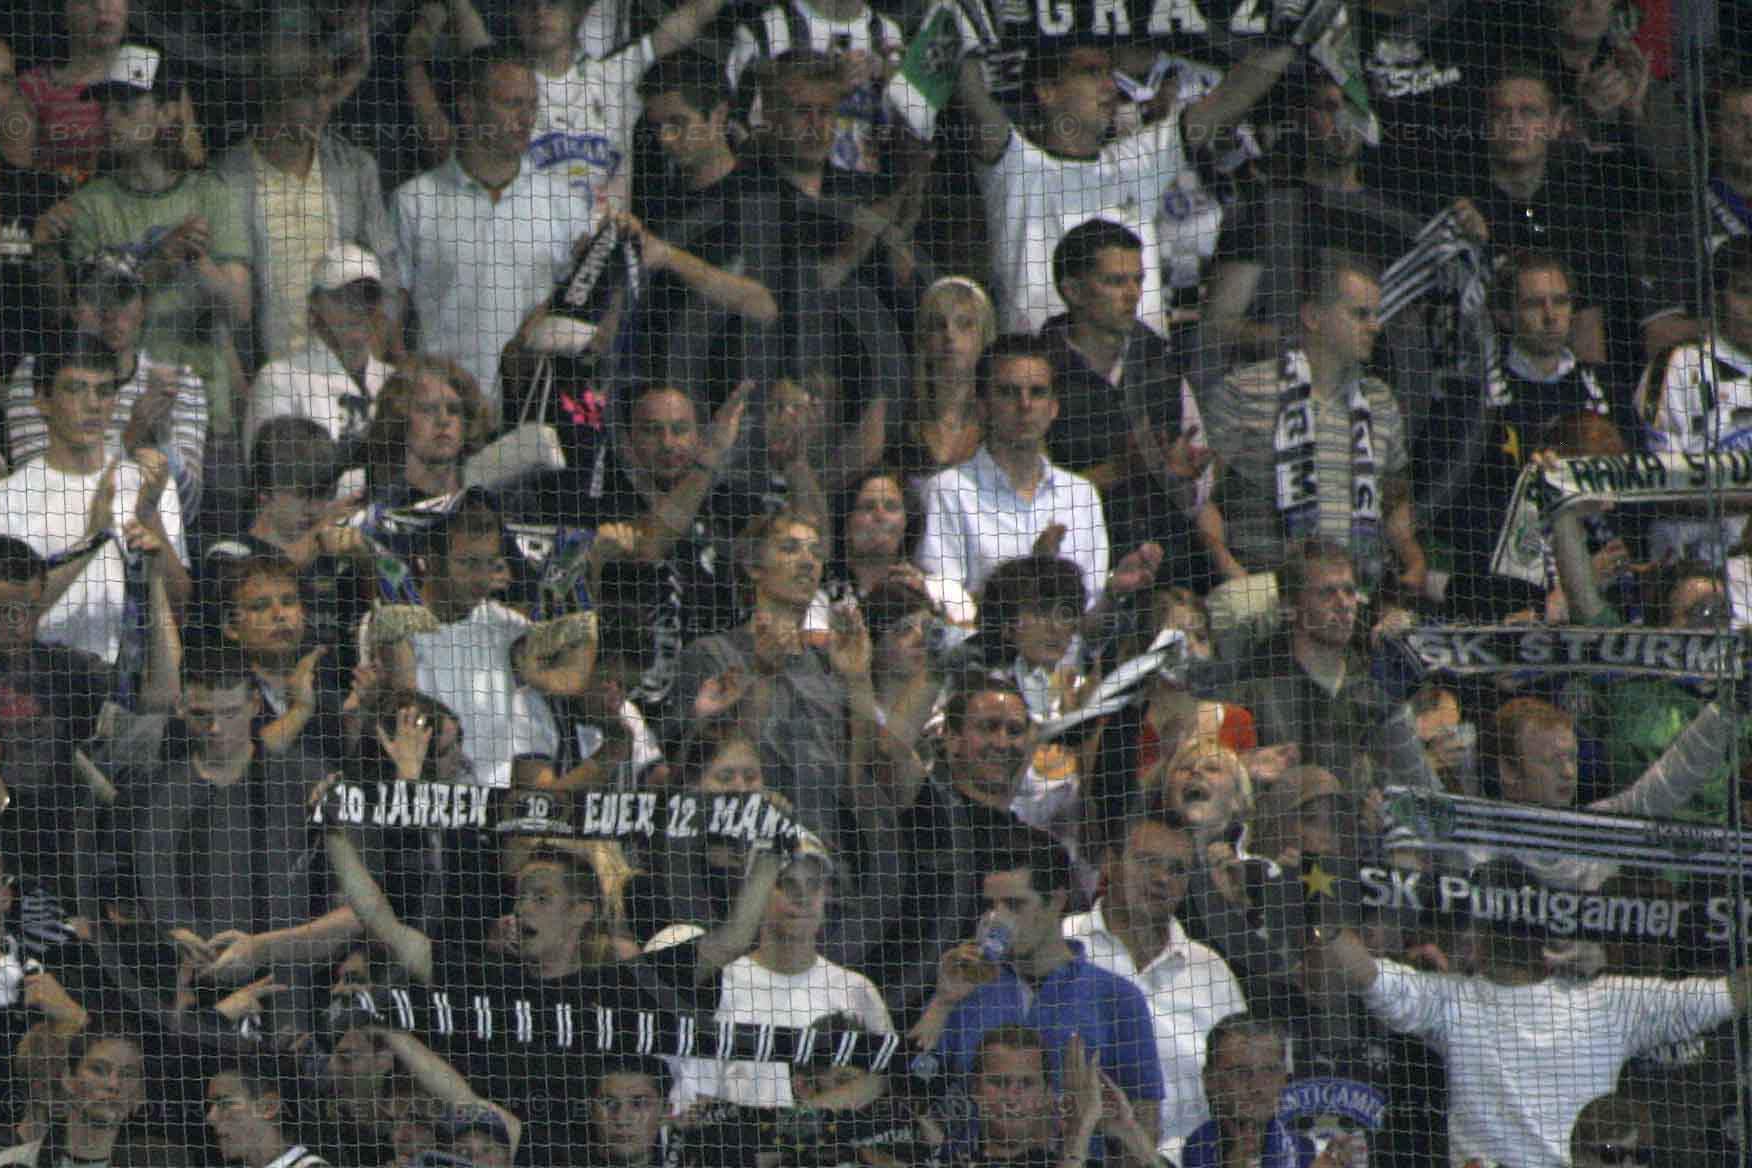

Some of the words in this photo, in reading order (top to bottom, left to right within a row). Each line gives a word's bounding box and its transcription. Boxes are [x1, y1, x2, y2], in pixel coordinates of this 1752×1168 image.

[1568, 451, 1667, 490] RAIKA
[1411, 630, 1499, 671] SK
[1519, 630, 1734, 676] STURM
[335, 782, 365, 824] 10
[372, 779, 491, 830] JAHREN
[583, 791, 656, 838] EUER
[1358, 866, 1423, 911] SK
[1438, 873, 1690, 940] Puntigamer
